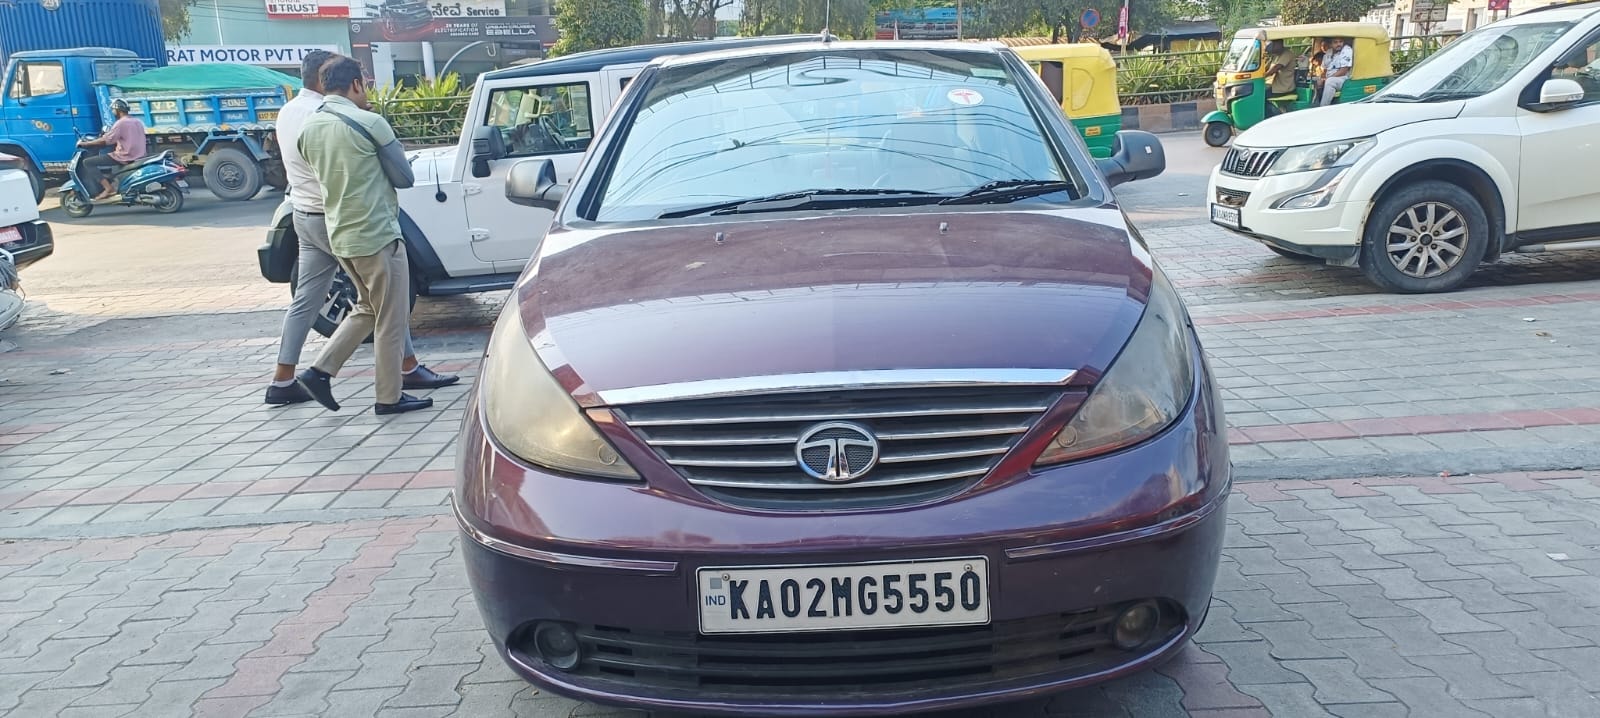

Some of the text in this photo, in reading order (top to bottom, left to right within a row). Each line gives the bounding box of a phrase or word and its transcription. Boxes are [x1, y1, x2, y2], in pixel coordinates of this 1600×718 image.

[279, 4, 316, 12] TRUST
[466, 7, 499, 16] Service
[201, 49, 261, 62] MOTOR
[266, 48, 293, 61] PVT
[705, 594, 726, 607] IND
[729, 570, 981, 620] KA02MG5550
